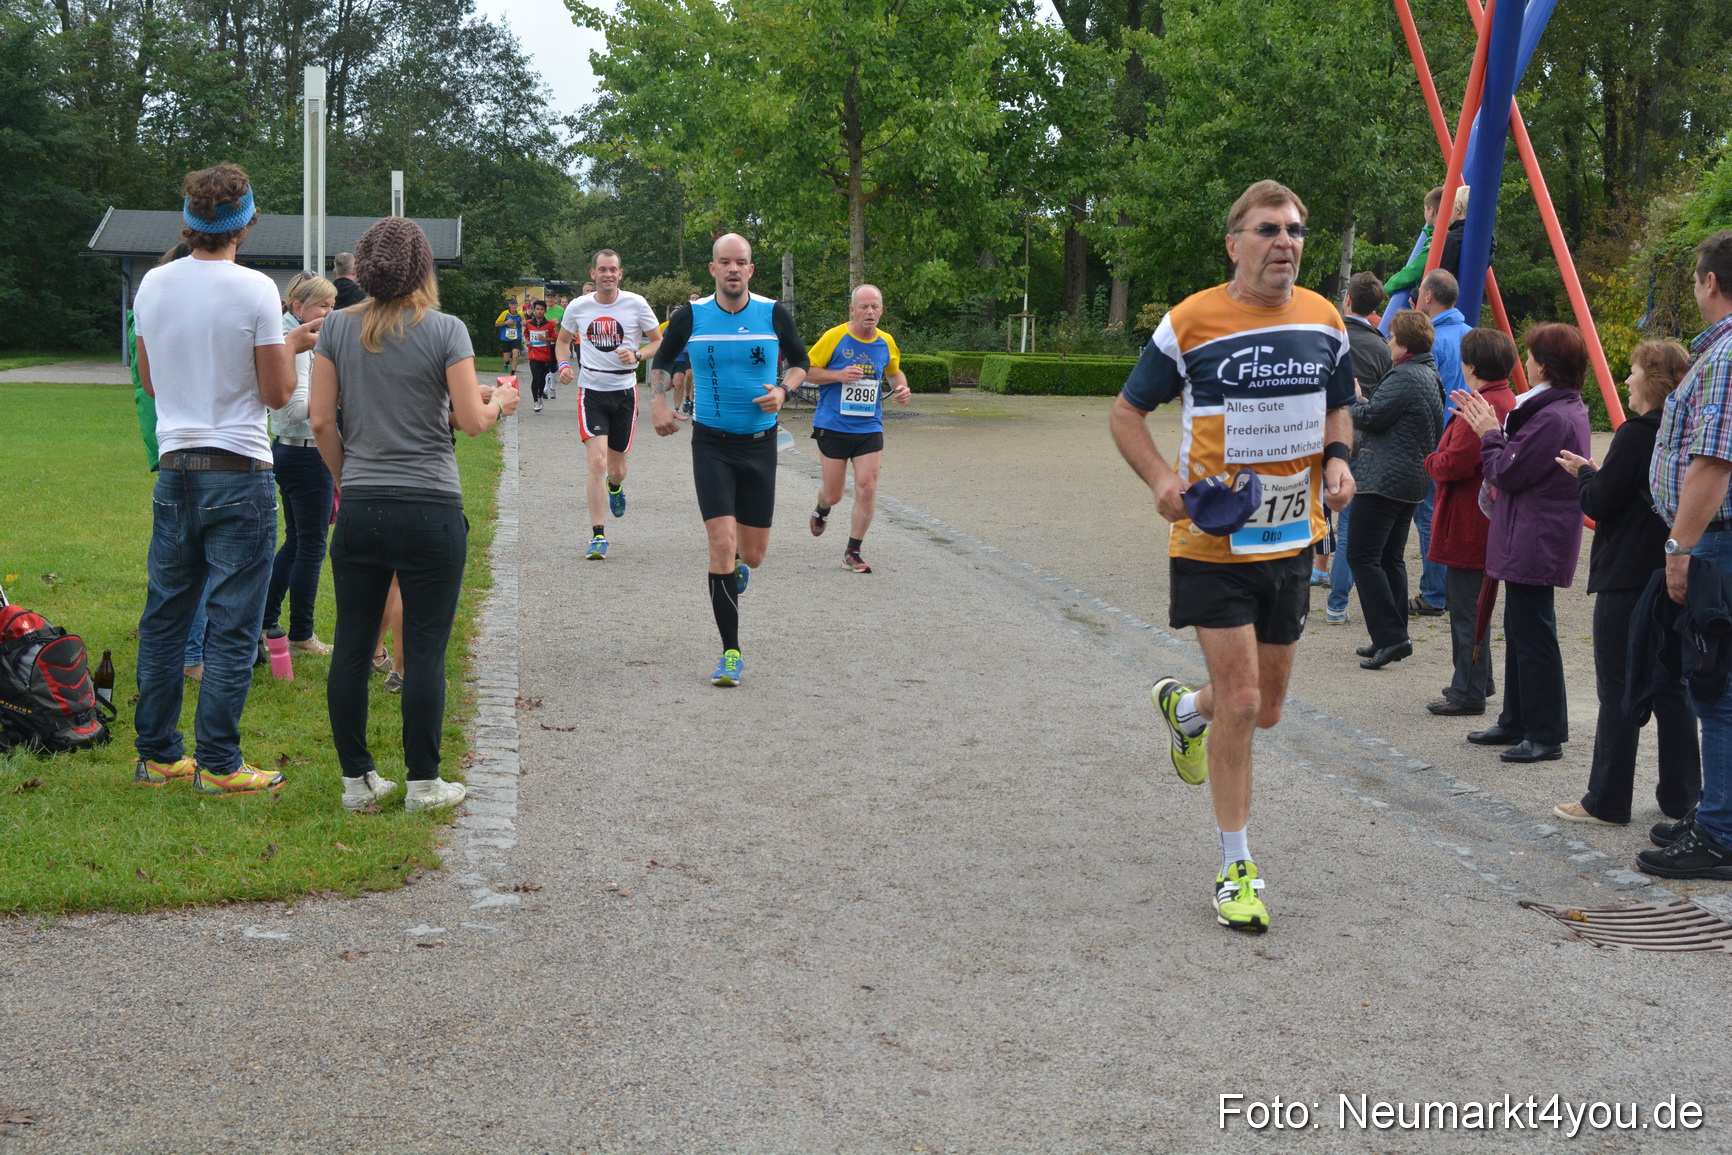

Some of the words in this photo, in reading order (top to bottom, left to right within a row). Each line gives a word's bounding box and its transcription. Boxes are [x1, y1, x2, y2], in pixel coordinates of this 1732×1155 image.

[593, 320, 618, 335] TOKYO
[591, 334, 621, 347] RUNNER
[1238, 358, 1323, 380] Fischer
[707, 346, 721, 417] BAVARTRIA
[1248, 377, 1320, 389] AUTOMOBILE
[845, 388, 875, 402] 2898
[1226, 402, 1254, 413] Alles
[1258, 402, 1285, 413] Gute
[1226, 423, 1281, 436] Frederika
[1283, 421, 1303, 433] und
[1305, 420, 1319, 430] Jan
[1226, 447, 1264, 459] Carina
[1266, 445, 1288, 456] und
[1271, 480, 1305, 492] Neumarkt
[1249, 490, 1306, 523] 175
[1262, 530, 1282, 541] Otto
